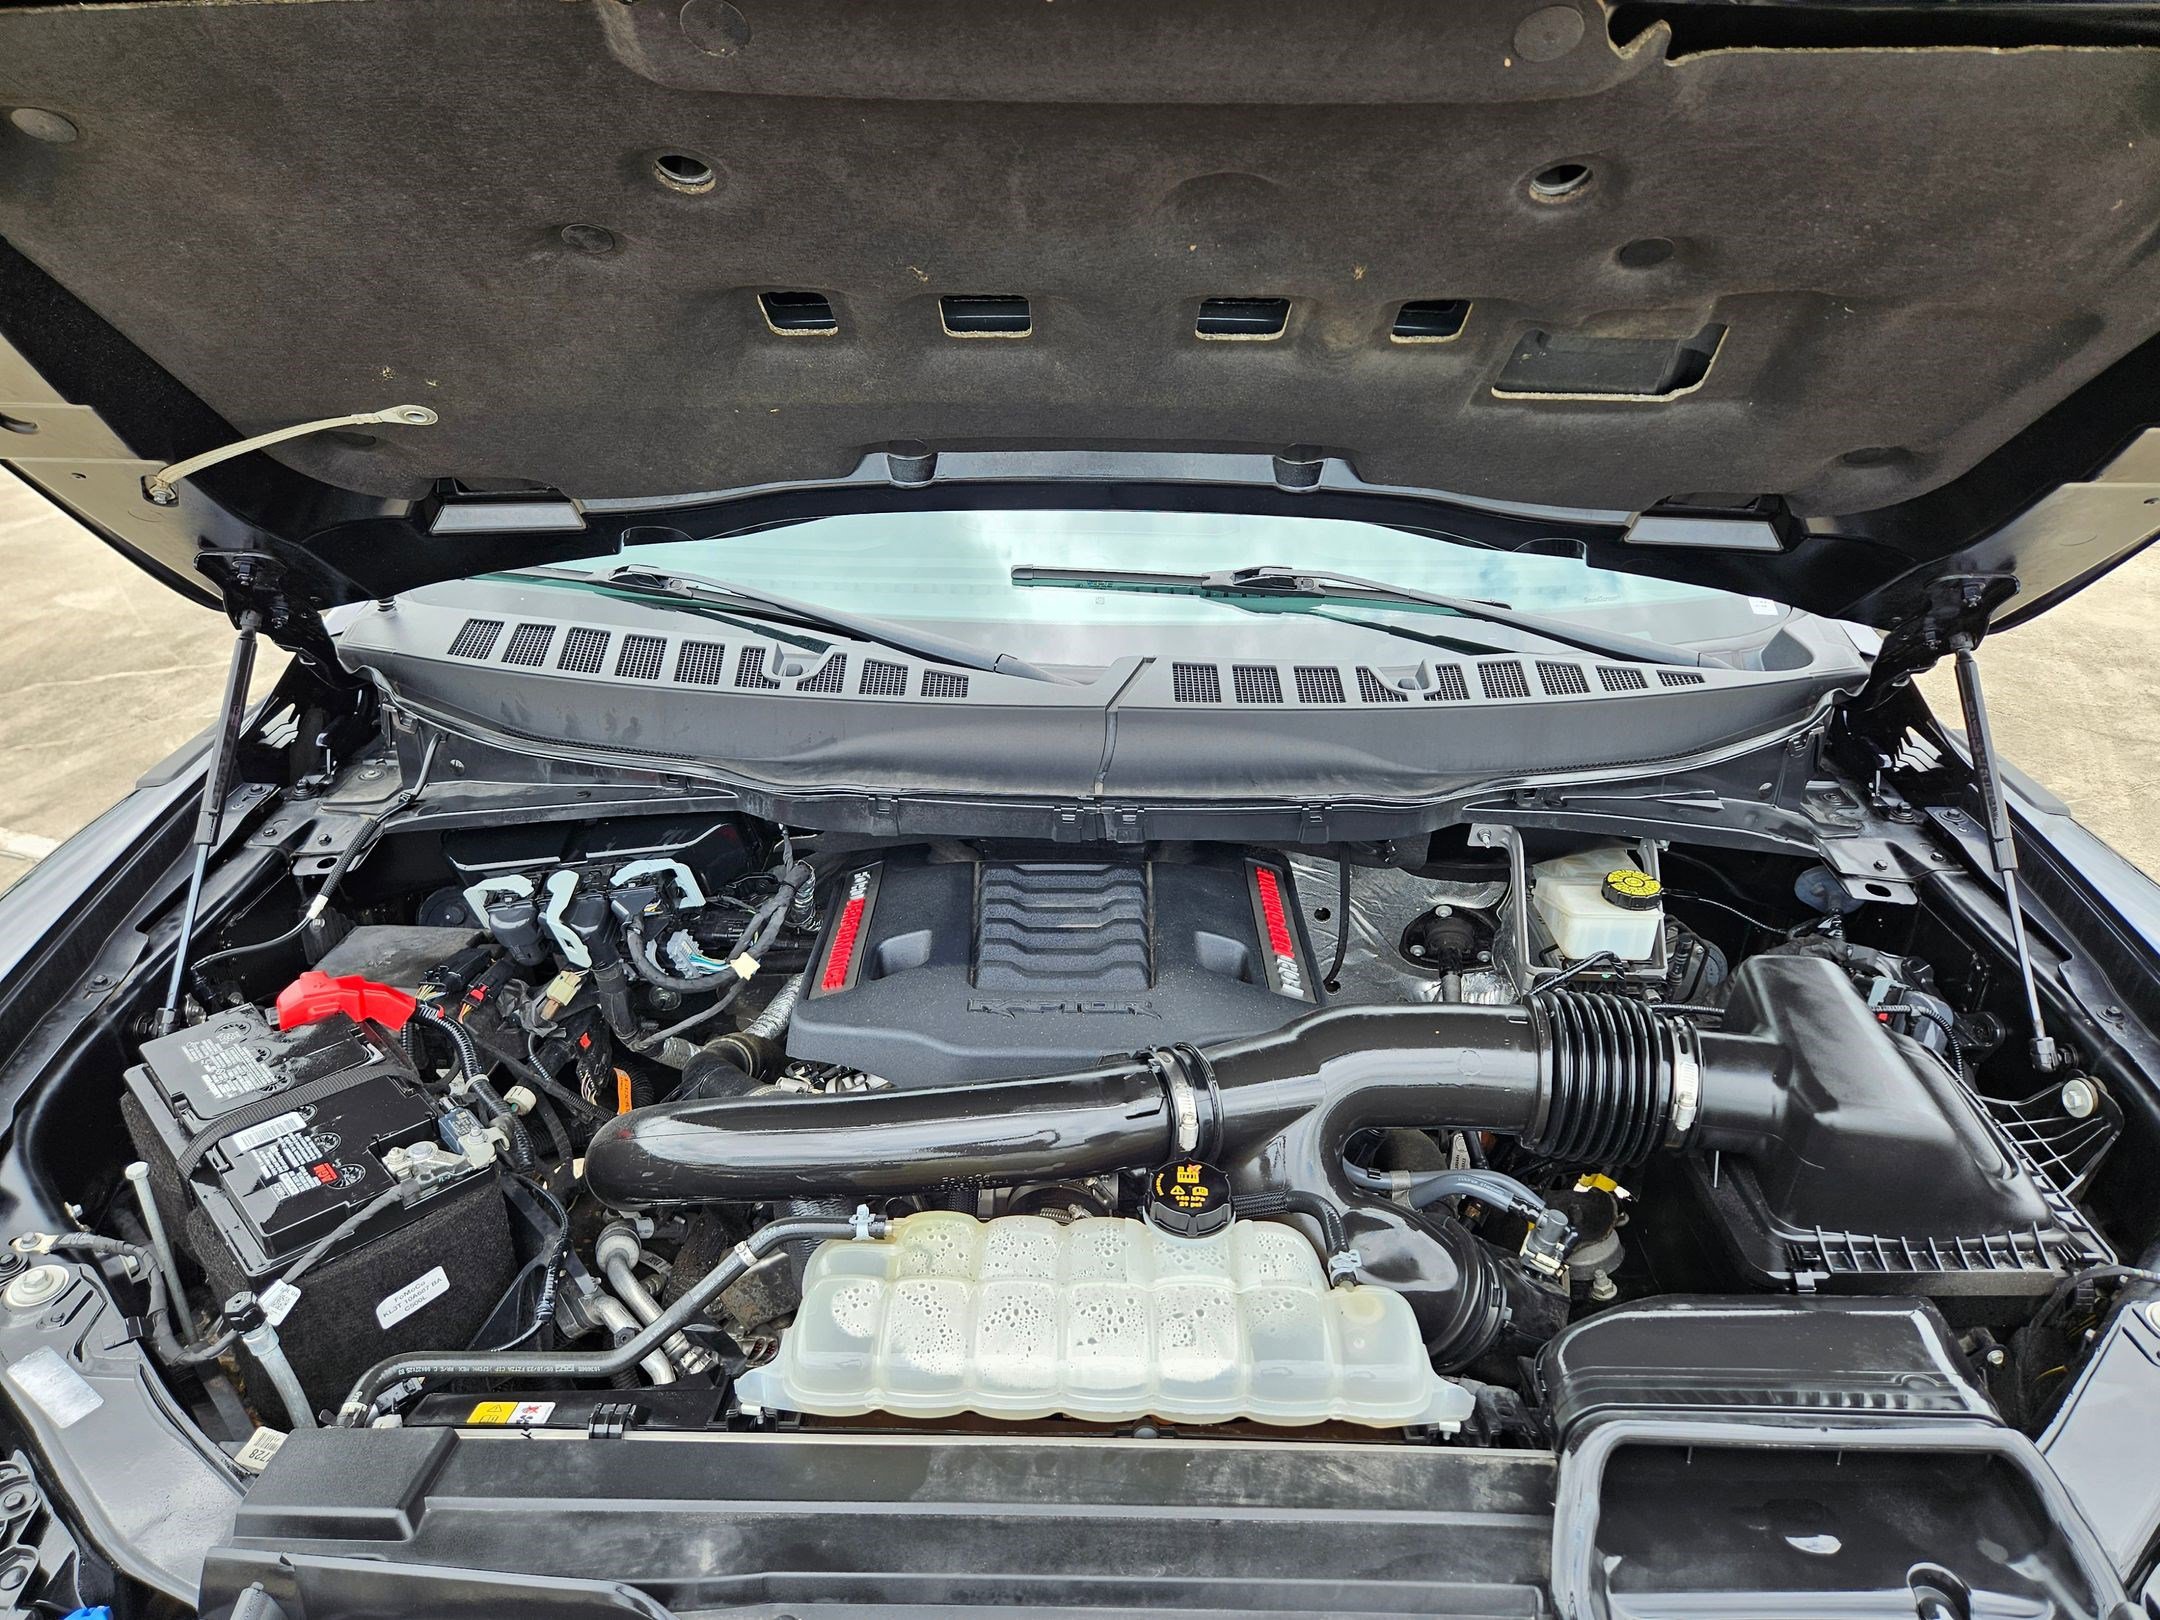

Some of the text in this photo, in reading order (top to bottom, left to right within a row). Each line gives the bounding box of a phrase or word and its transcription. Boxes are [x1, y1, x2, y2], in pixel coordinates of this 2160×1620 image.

[1255, 866, 1305, 998] FORD PERFORMANCE
[966, 998, 1163, 1020] RAPTOR
[313, 1164, 334, 1184] AGM
[394, 1281, 426, 1303] FoMoCo
